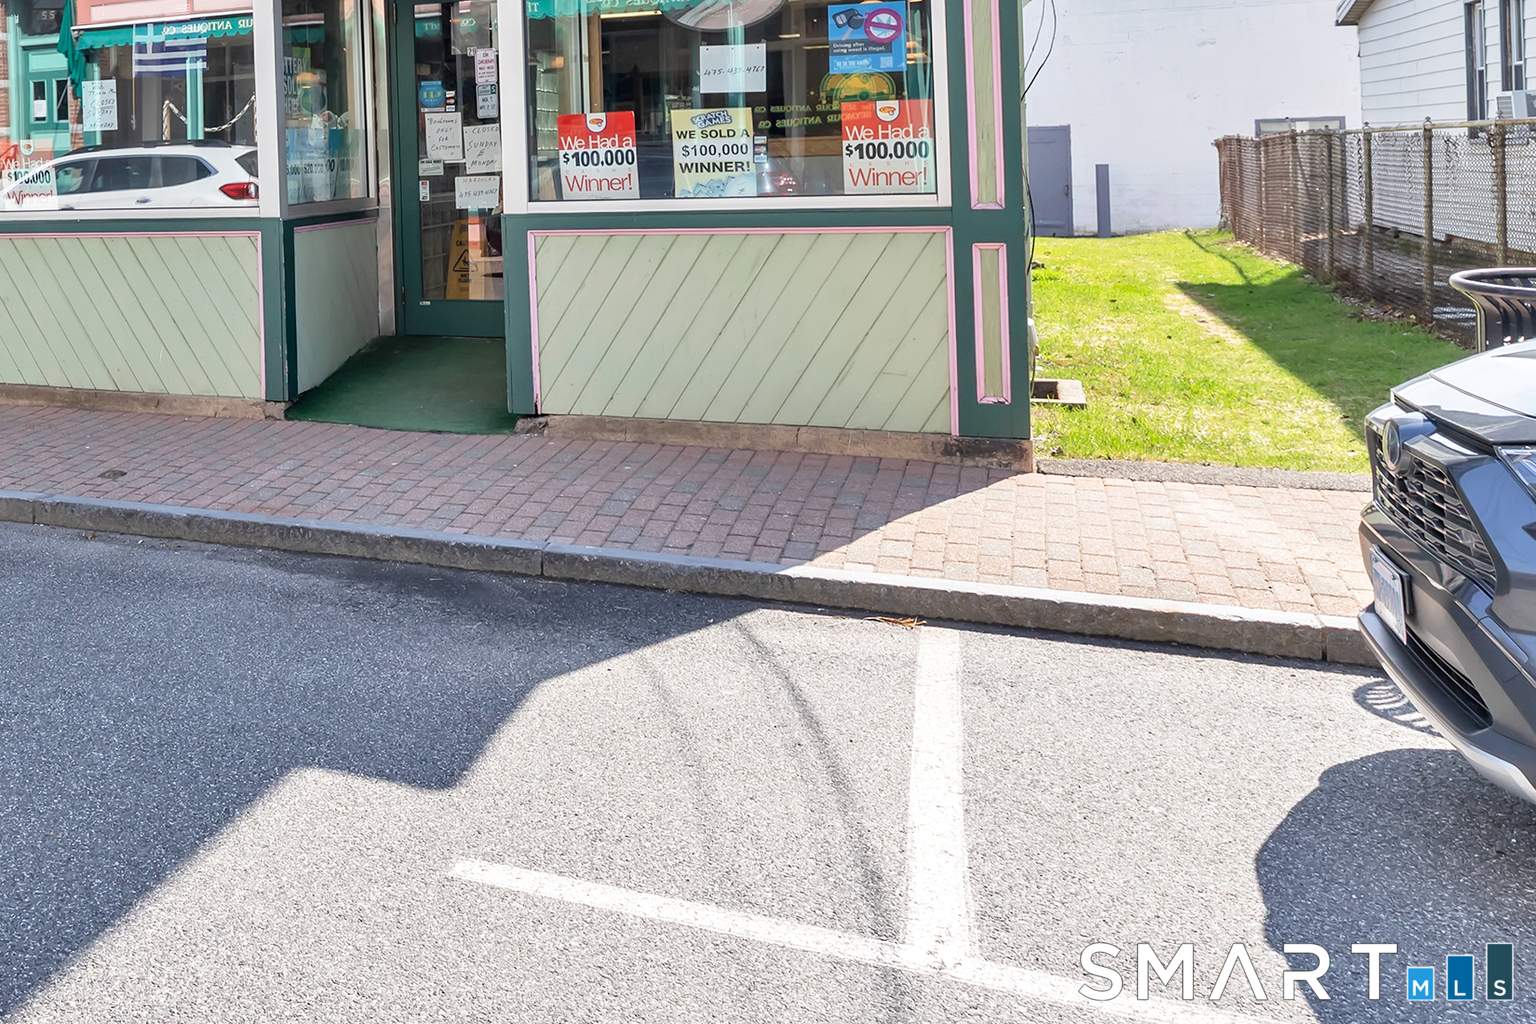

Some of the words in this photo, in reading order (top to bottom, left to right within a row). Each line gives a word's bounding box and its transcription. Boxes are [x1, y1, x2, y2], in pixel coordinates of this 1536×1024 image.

[284, 57, 307, 74] TTERY
[691, 110, 728, 123] SCRATCH
[697, 116, 733, 129] GAMES
[676, 130, 696, 139] WE
[700, 129, 736, 139] SOLD
[740, 128, 750, 138] A
[845, 126, 874, 141] We
[878, 124, 914, 140] Had
[918, 126, 930, 138] a
[467, 140, 498, 151] SUNDAY
[561, 137, 585, 150] We
[589, 134, 619, 149] Had
[622, 136, 633, 148] a
[681, 143, 749, 158] $100,000
[845, 141, 930, 159] $100,000
[3, 159, 20, 170] We
[23, 157, 43, 169] Had
[563, 149, 635, 167] $100,000
[679, 161, 751, 173] WINNER!
[565, 173, 633, 192] Winner!
[848, 166, 928, 187] Winner!
[7, 190, 53, 204] Winner!
